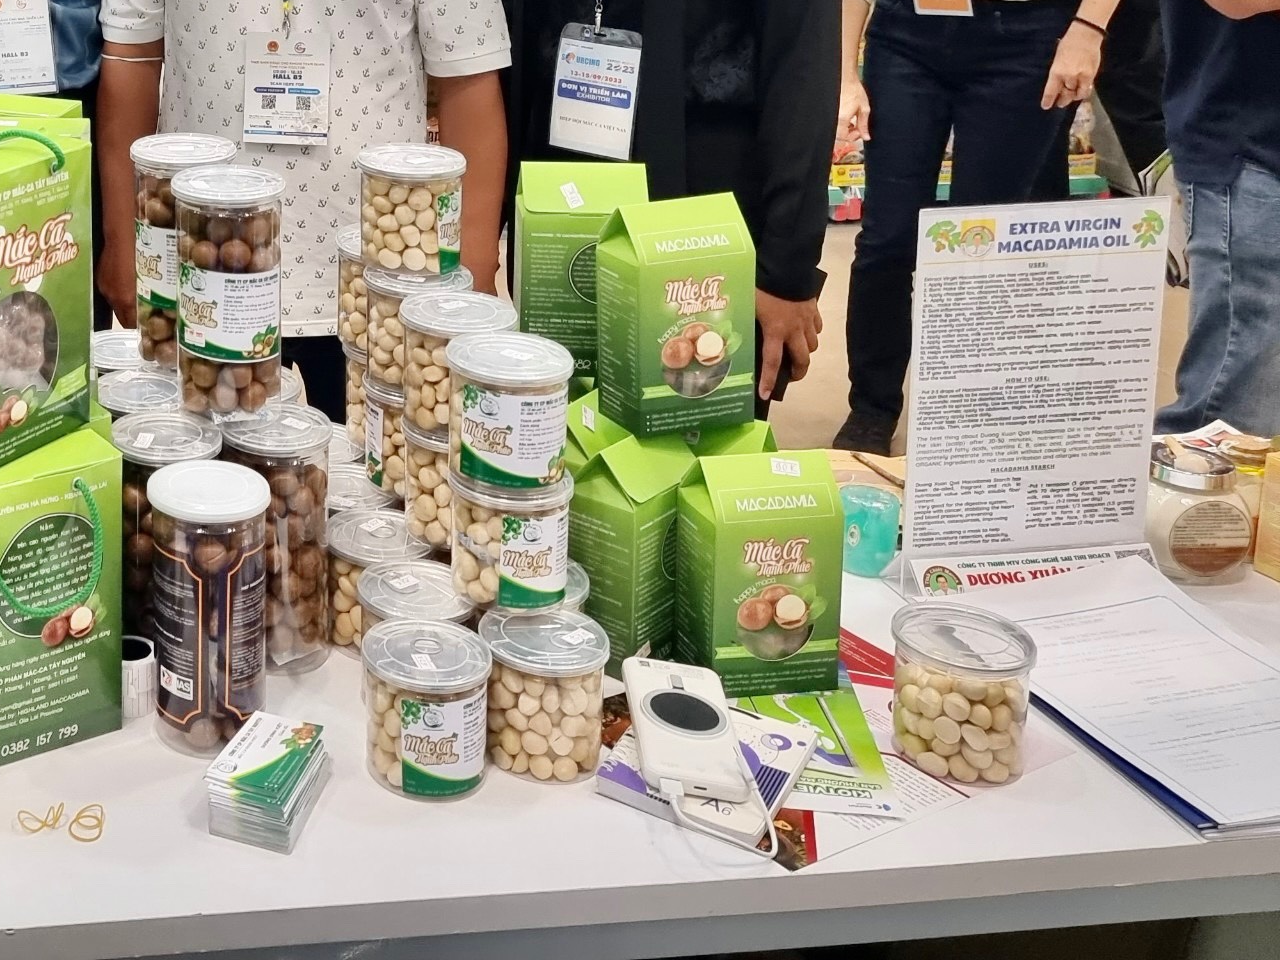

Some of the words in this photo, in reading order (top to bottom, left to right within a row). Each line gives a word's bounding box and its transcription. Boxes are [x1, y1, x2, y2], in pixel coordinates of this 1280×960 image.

[577, 92, 610, 102] EXHIBITOR
[1009, 222, 1060, 235] EXTRA
[1064, 217, 1122, 231] VIRGIN
[655, 234, 730, 254] MACADAMIA
[997, 237, 1099, 253] MACADAMIA
[1101, 235, 1130, 247] OIL
[736, 494, 817, 513] MACADAMIA
[957, 561, 977, 569] CÔNG
[1021, 557, 1040, 565] CÔNG
[966, 570, 1025, 586] DƯƠNG
[1, 739, 29, 757] 0382
[36, 732, 52, 746] 157
[58, 724, 78, 739] 799
